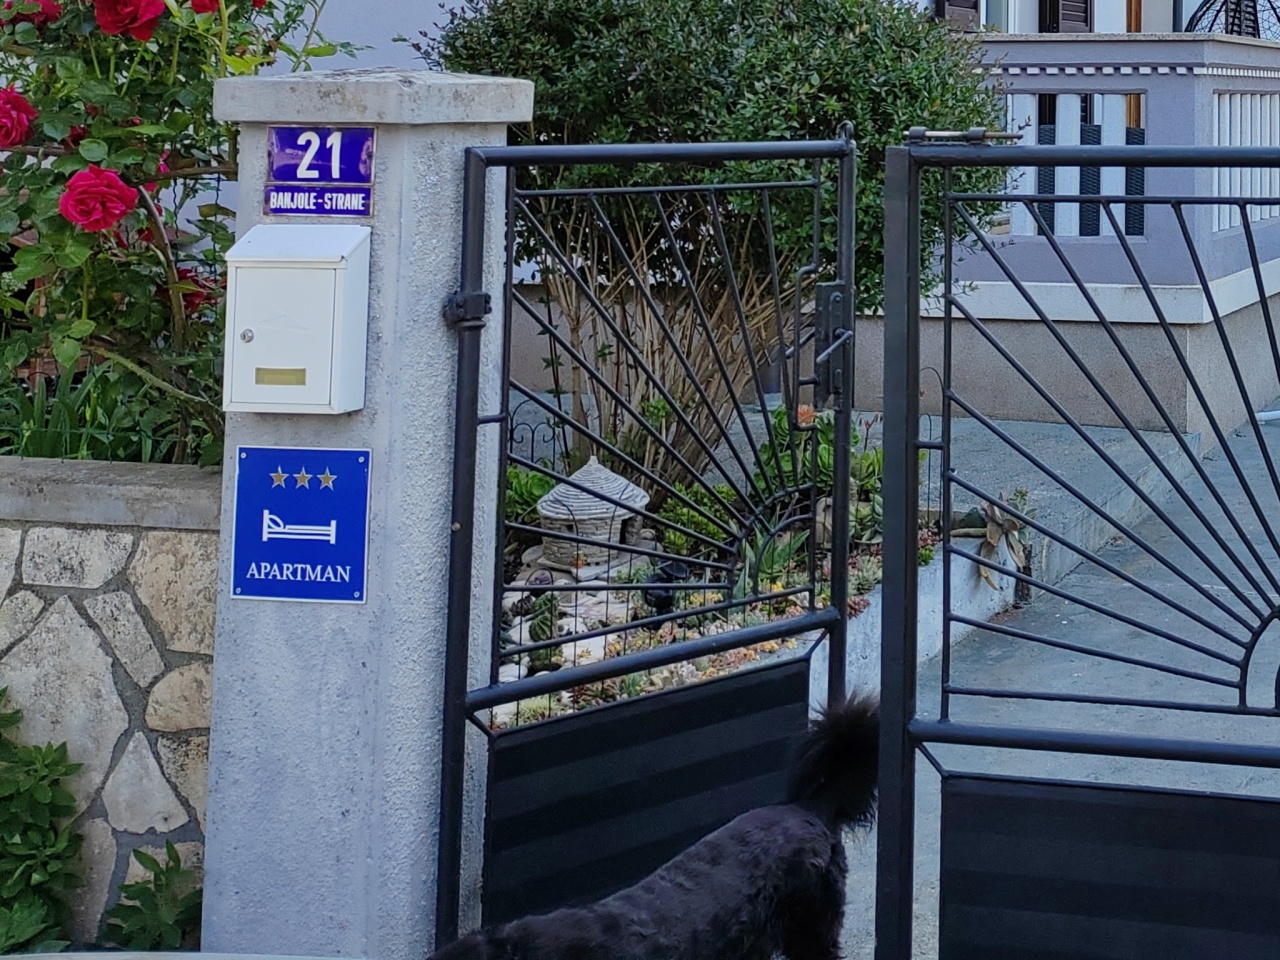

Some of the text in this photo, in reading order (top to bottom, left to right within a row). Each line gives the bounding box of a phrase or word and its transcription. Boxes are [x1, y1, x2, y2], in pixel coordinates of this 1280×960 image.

[297, 131, 342, 179] 21
[270, 191, 366, 210] BANJOLE-STRANE
[246, 562, 351, 583] APARTMAN
